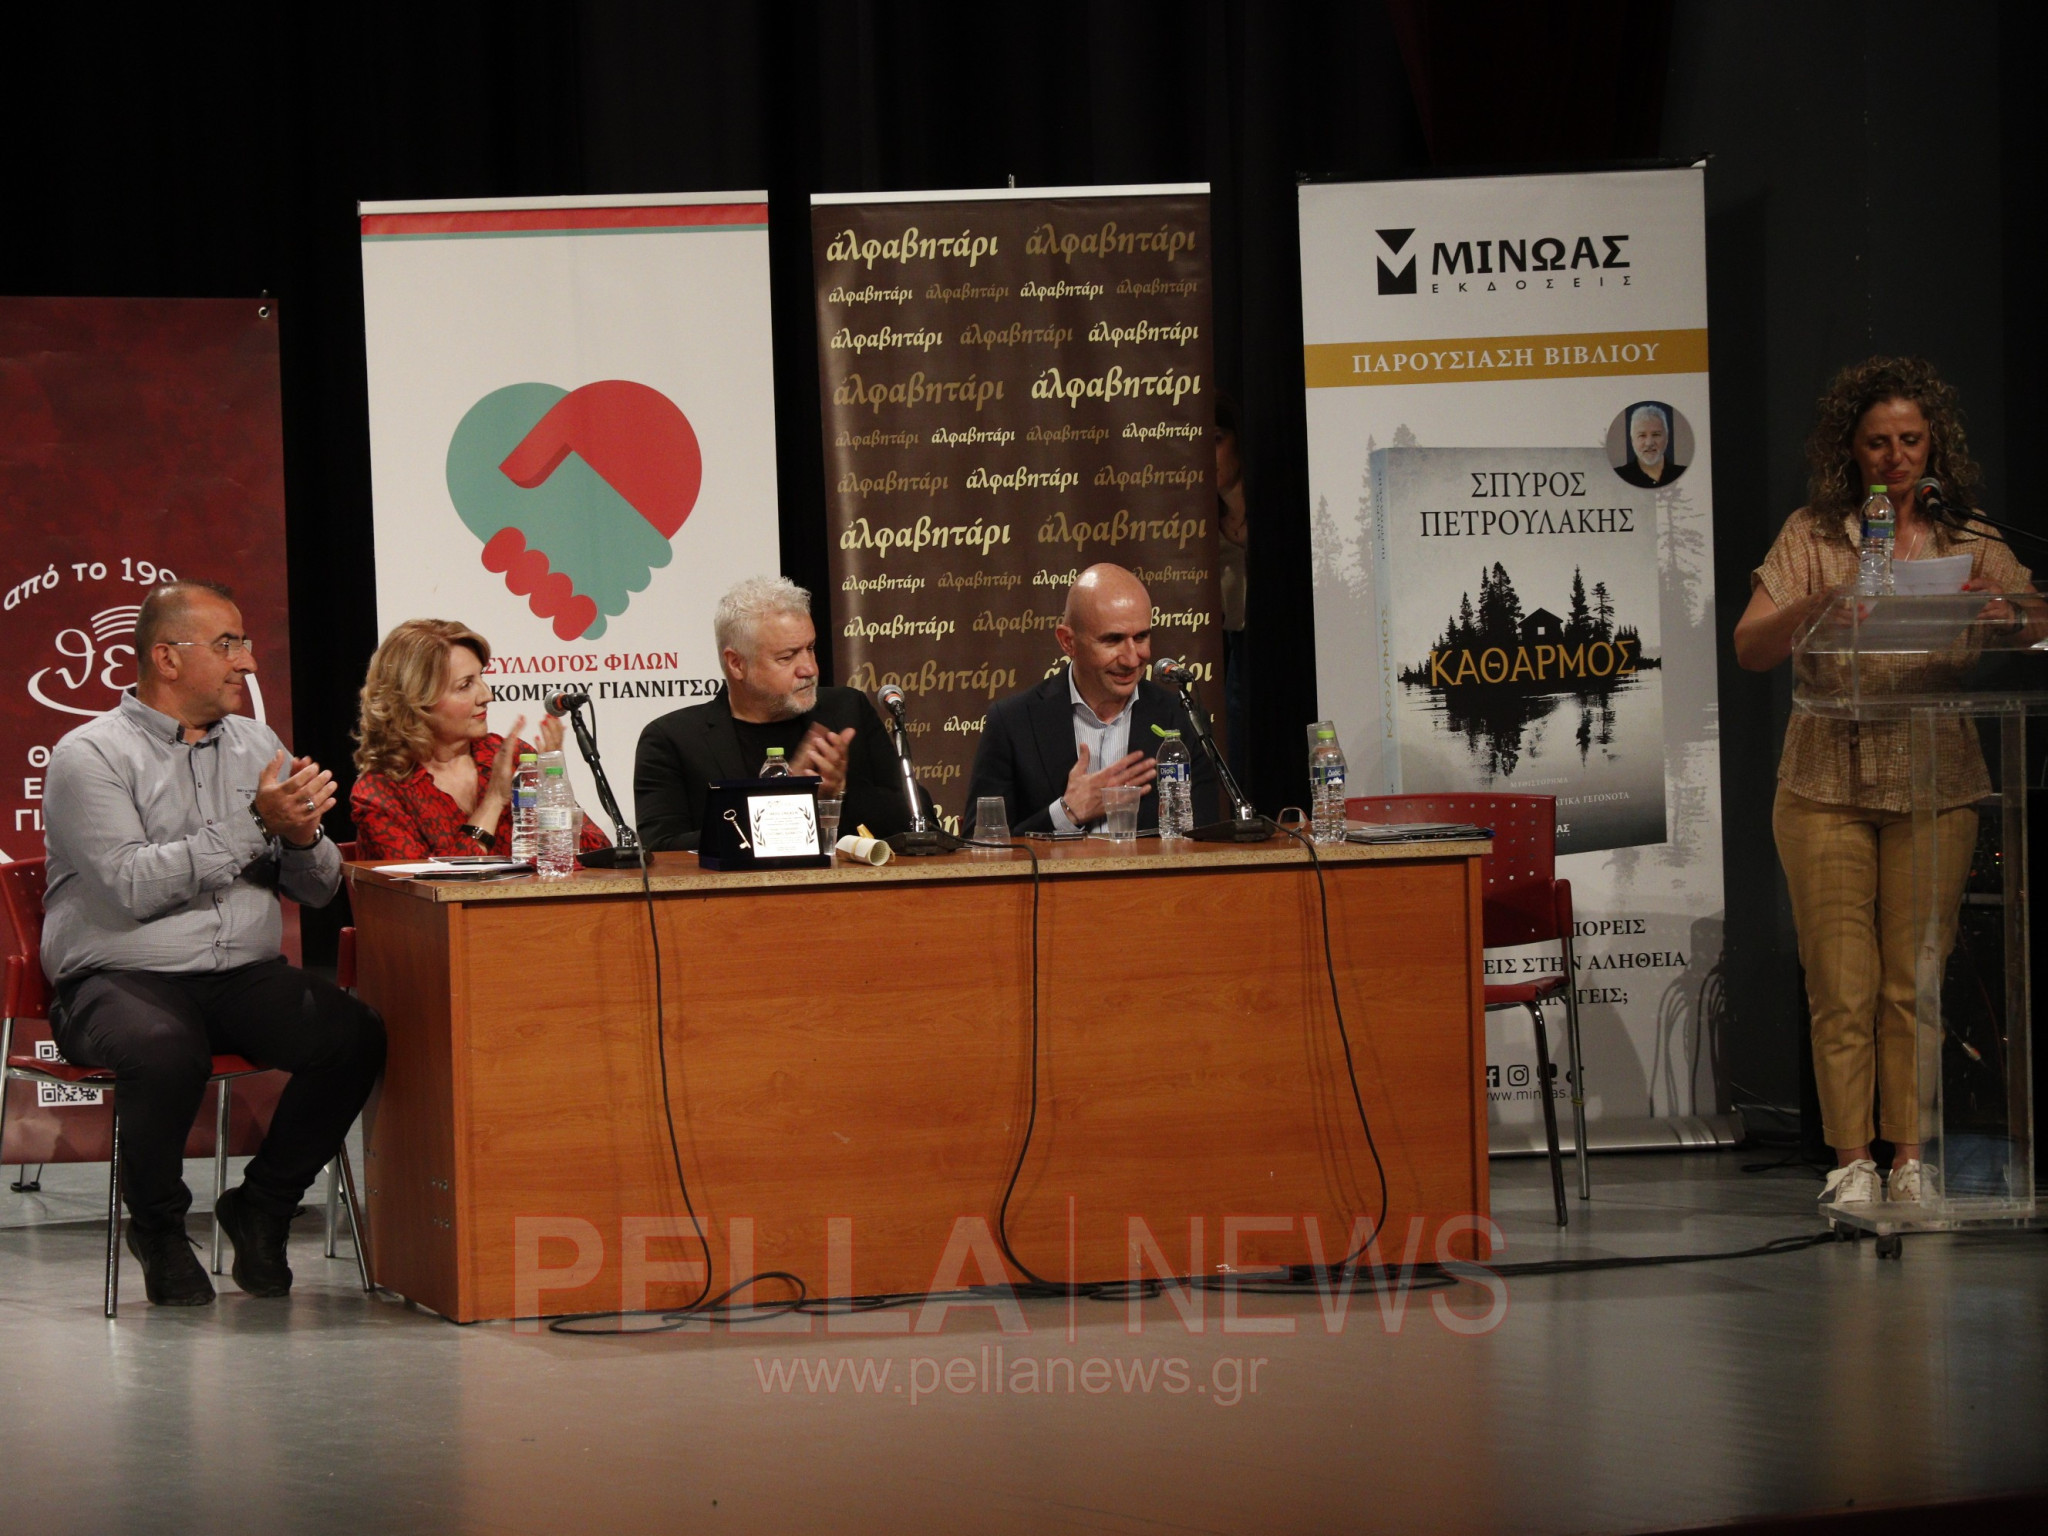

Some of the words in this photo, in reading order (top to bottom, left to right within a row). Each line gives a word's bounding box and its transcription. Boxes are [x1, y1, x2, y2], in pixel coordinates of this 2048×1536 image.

[1432, 234, 1631, 275] ΜΙΝΩΑΣ
[1432, 276, 1632, 294] ΕΚΔΟΣΕΙΣ
[1352, 347, 1535, 374] ΠΑΡΟΥΣΙΑΣΗ
[1545, 342, 1661, 367] ΒΙΒΛΙΟΥ
[1470, 471, 1587, 498] ΣΠΥΡΟΣ
[1420, 508, 1635, 537] ΠΕΤΡΟΥΛΑΚΗΣ
[3, 563, 59, 611] από
[71, 562, 107, 582] το
[483, 654, 598, 675] ΣΥΛΛΟΓΟΣ
[604, 652, 678, 671] ΦΙΛΩΝ
[1429, 640, 1637, 687] ΚΑΘΑΡΜΟΣ
[599, 678, 727, 699] ΓΙΑΝΝΙΤΣΩ
[1583, 791, 1630, 803] ΓΕΓΟΝΟΤΑ
[1588, 951, 1687, 970] ΑΛΗΘΕΙΑ
